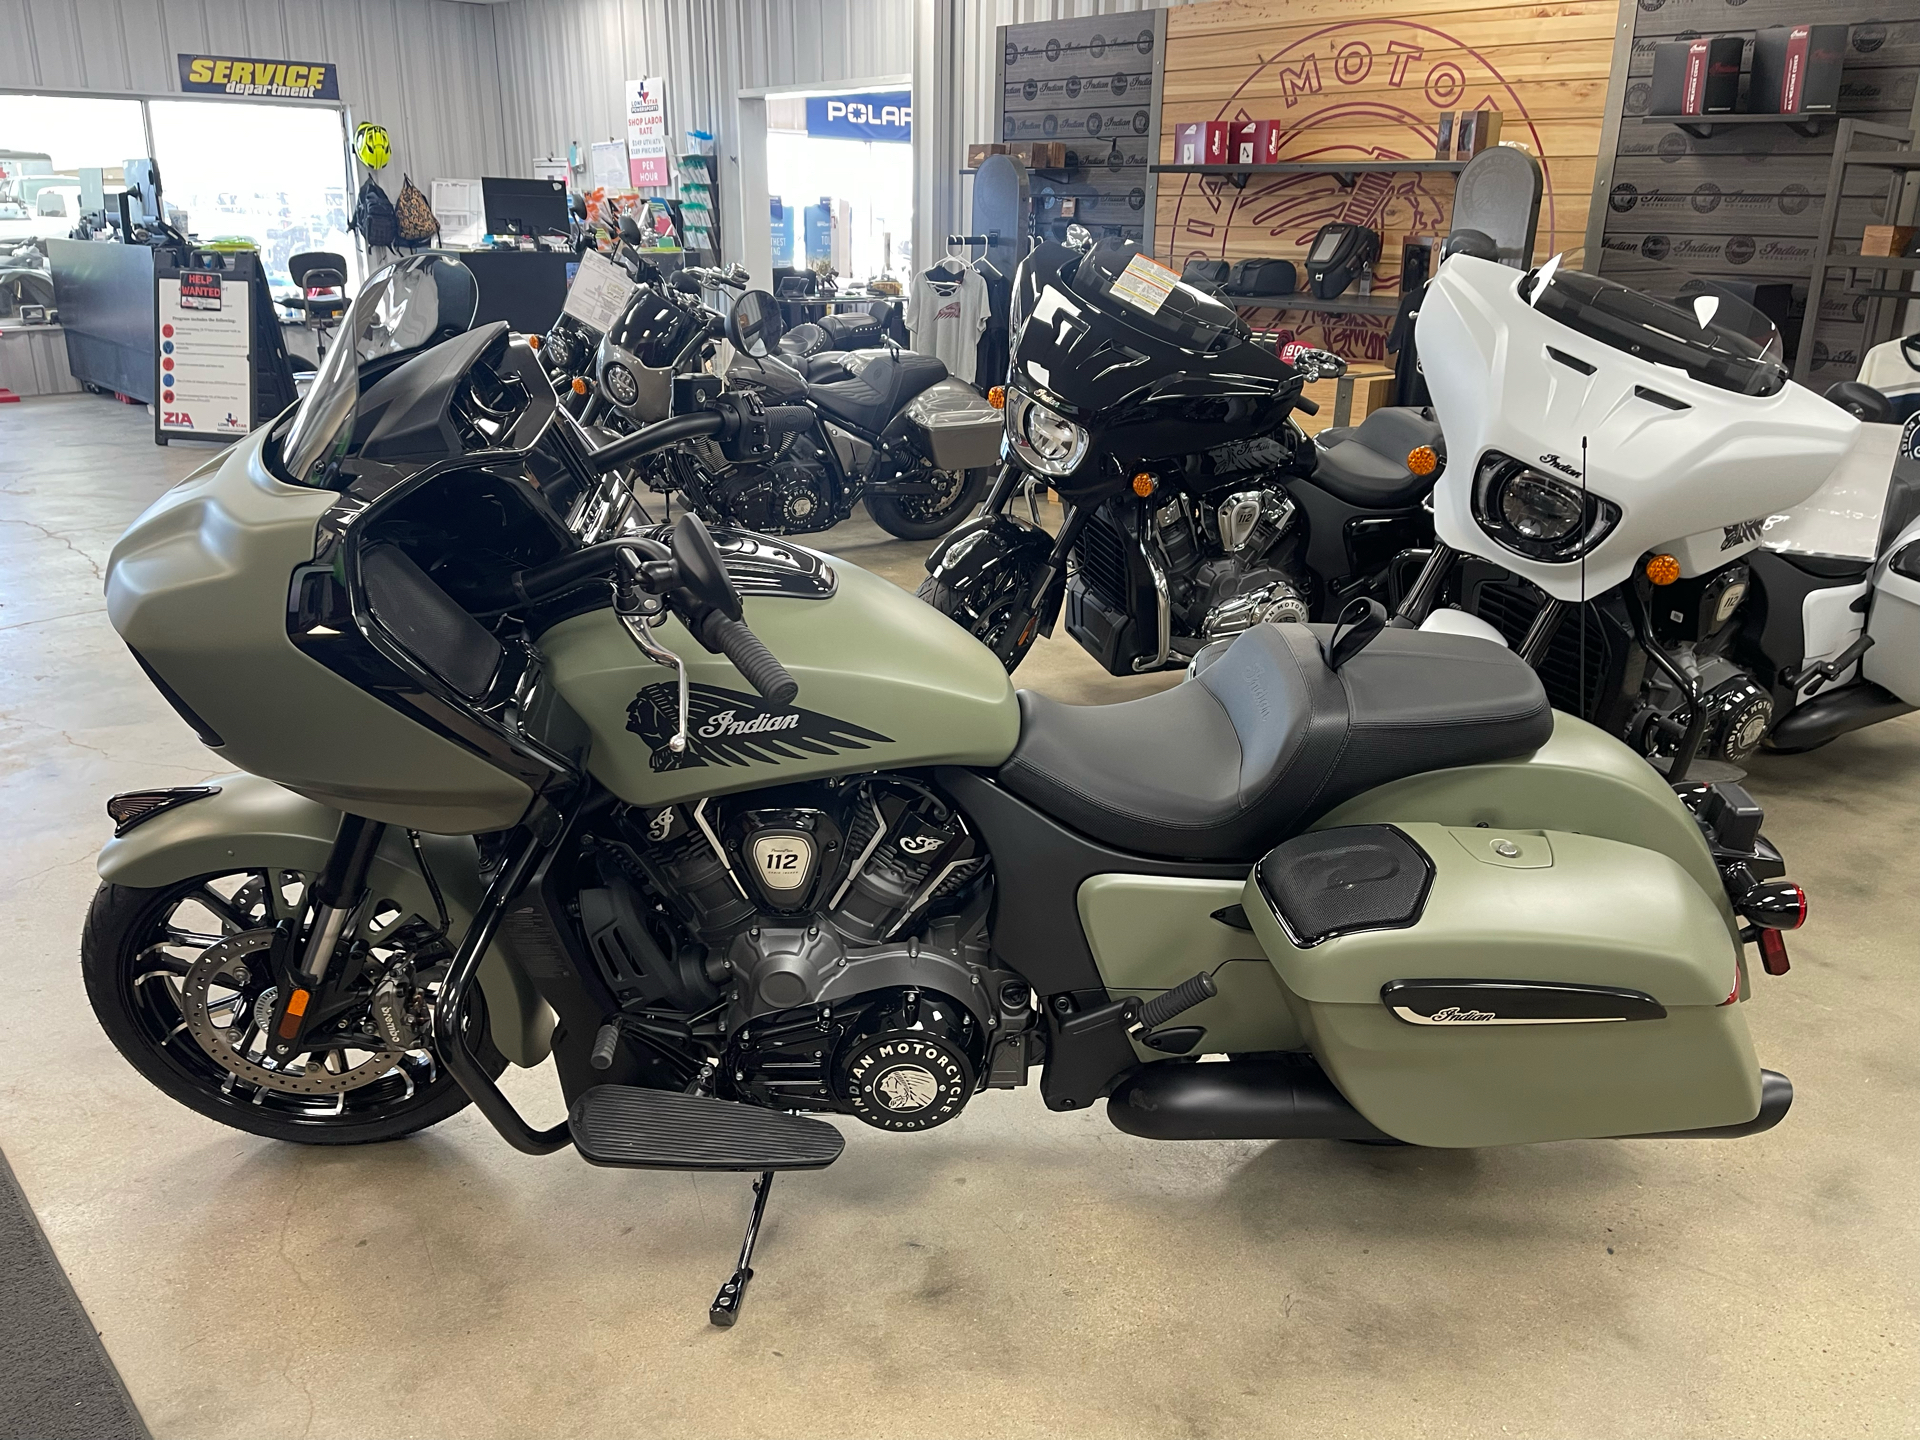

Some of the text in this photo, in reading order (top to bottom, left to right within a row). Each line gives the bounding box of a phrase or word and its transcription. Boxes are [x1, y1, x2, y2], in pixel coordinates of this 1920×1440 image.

[189, 59, 325, 90] SERVICE
[1279, 41, 1502, 110] MOTO
[225, 80, 315, 98] department
[1040, 82, 1064, 92] Indian
[1083, 79, 1109, 90] Indian
[628, 115, 662, 126] SHOP LABOR
[1104, 116, 1131, 127] Indian
[639, 126, 653, 135] RATE
[642, 161, 655, 171] PER
[1079, 155, 1106, 165] Indian
[640, 172, 658, 182] HOUR
[1673, 239, 1721, 254] Indian
[1760, 241, 1810, 256] Indian
[188, 274, 213, 285] HELP
[181, 286, 220, 297] WANTED
[163, 412, 194, 425] ZIA
[1236, 441, 1271, 456] Indian
[1539, 453, 1583, 479] Indian
[1238, 513, 1253, 523] 112
[1723, 595, 1739, 608] 112
[699, 709, 800, 738] Indian
[766, 853, 799, 869] 112
[1431, 1006, 1496, 1022] Indian
[380, 1006, 401, 1043] brembo
[849, 1042, 963, 1114] INDIAN MOTORCYCLE
